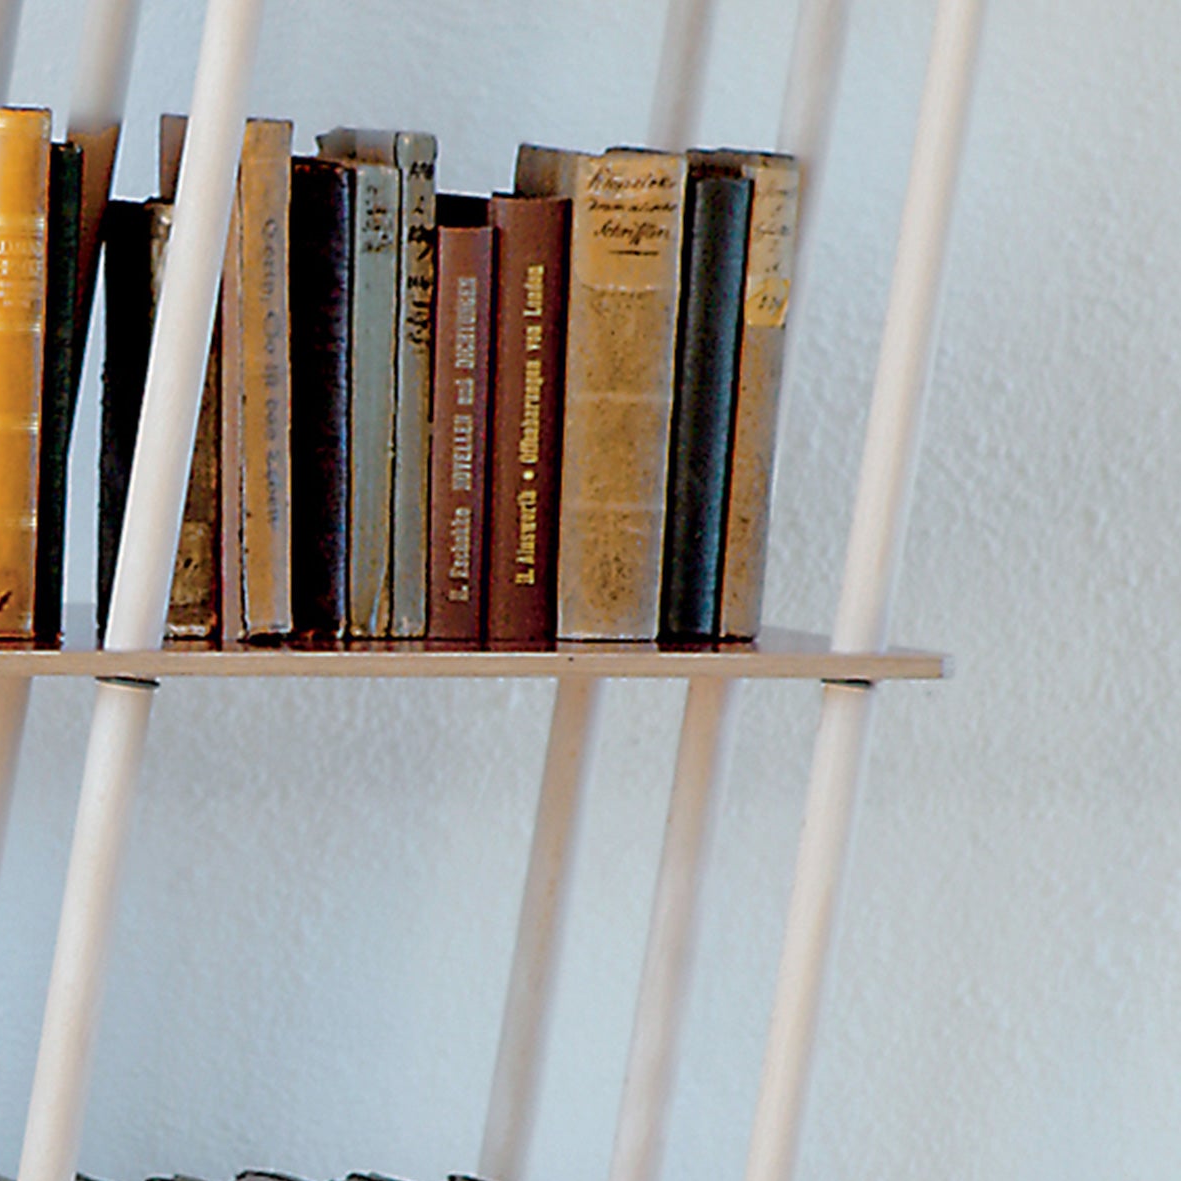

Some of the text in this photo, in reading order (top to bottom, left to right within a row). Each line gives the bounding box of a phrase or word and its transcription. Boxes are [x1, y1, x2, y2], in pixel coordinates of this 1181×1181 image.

[454, 276, 477, 370] DICHTUNGEN
[522, 264, 545, 317] London
[525, 324, 543, 351] von
[519, 359, 544, 464] Offenbarungen
[451, 413, 473, 491] NOVELLEN
[515, 490, 537, 564] Ainsworth
